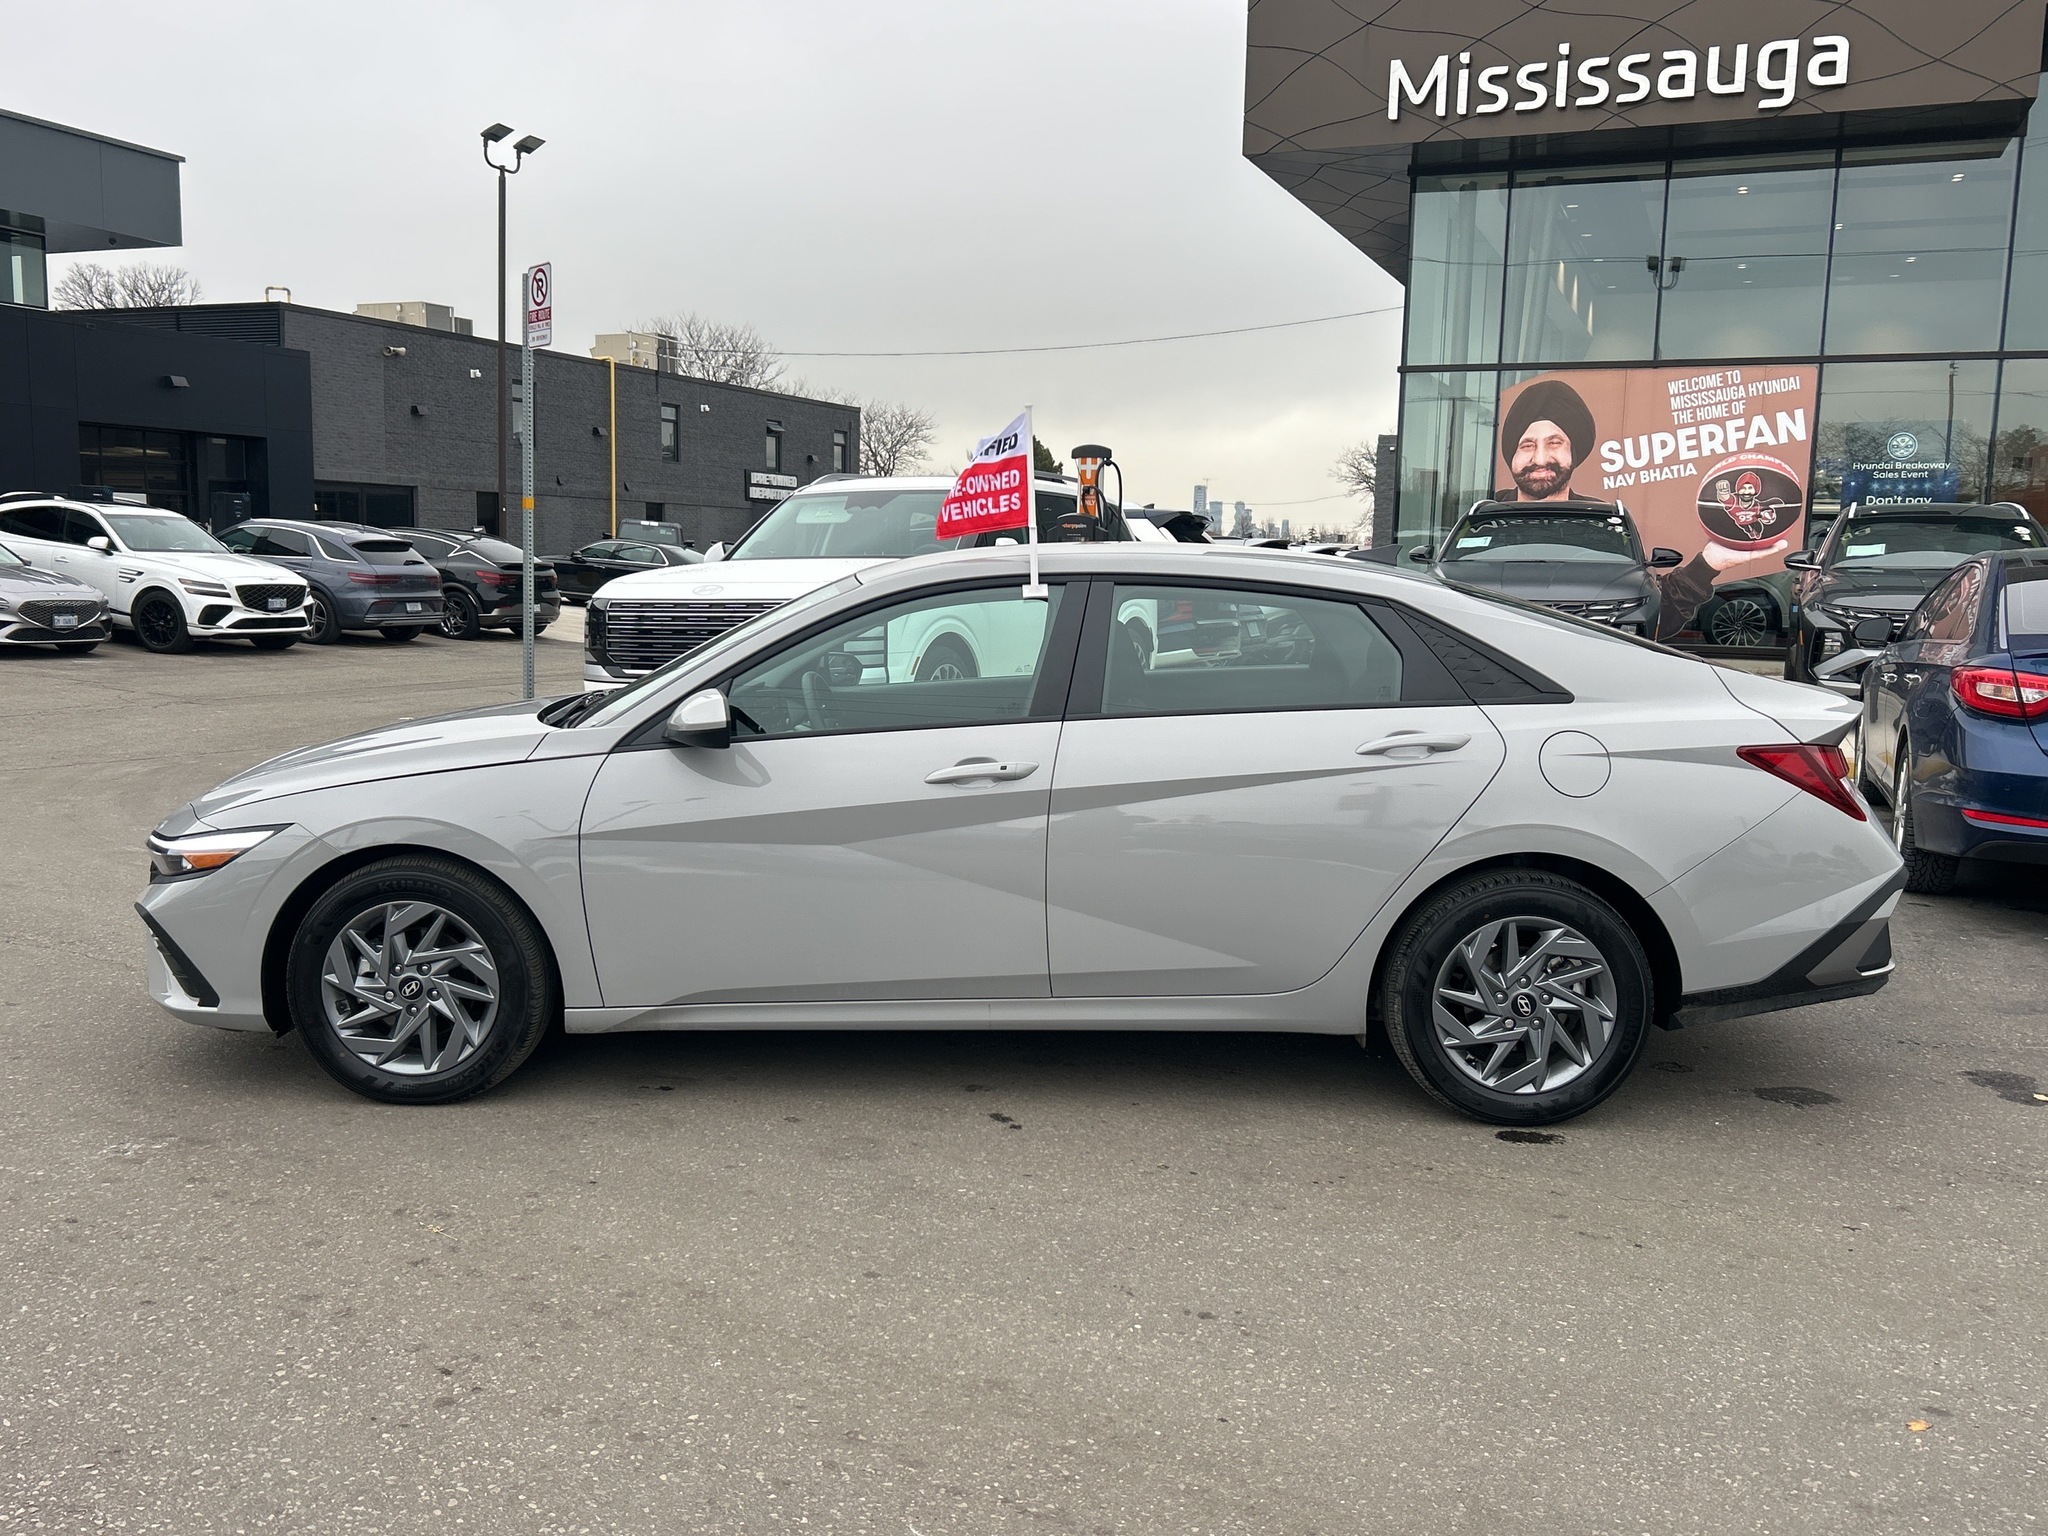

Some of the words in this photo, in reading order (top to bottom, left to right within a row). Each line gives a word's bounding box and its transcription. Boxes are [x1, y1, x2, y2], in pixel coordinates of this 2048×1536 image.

[1387, 34, 1850, 121] Mississauga
[1667, 374, 1724, 395] WELCOME
[1725, 370, 1741, 385] TO
[1670, 384, 1746, 411] MISSISSAUGA
[1748, 376, 1800, 397] HYUNDAI
[1671, 409, 1694, 425] THE
[1696, 403, 1729, 423] HOME
[1732, 400, 1746, 415] OF
[1599, 408, 1807, 473] SUPERFAN
[1602, 472, 1636, 490] NAV
[1639, 462, 1697, 482] BHATIA
[1852, 462, 1893, 471] Hyundai
[1895, 461, 1951, 470] Breakaway
[1873, 471, 1899, 479] Sales
[1901, 470, 1928, 478] Event
[750, 472, 798, 488] PRE-OWNED
[942, 492, 1021, 522] VEHICLES
[1866, 495, 1902, 505] Don't
